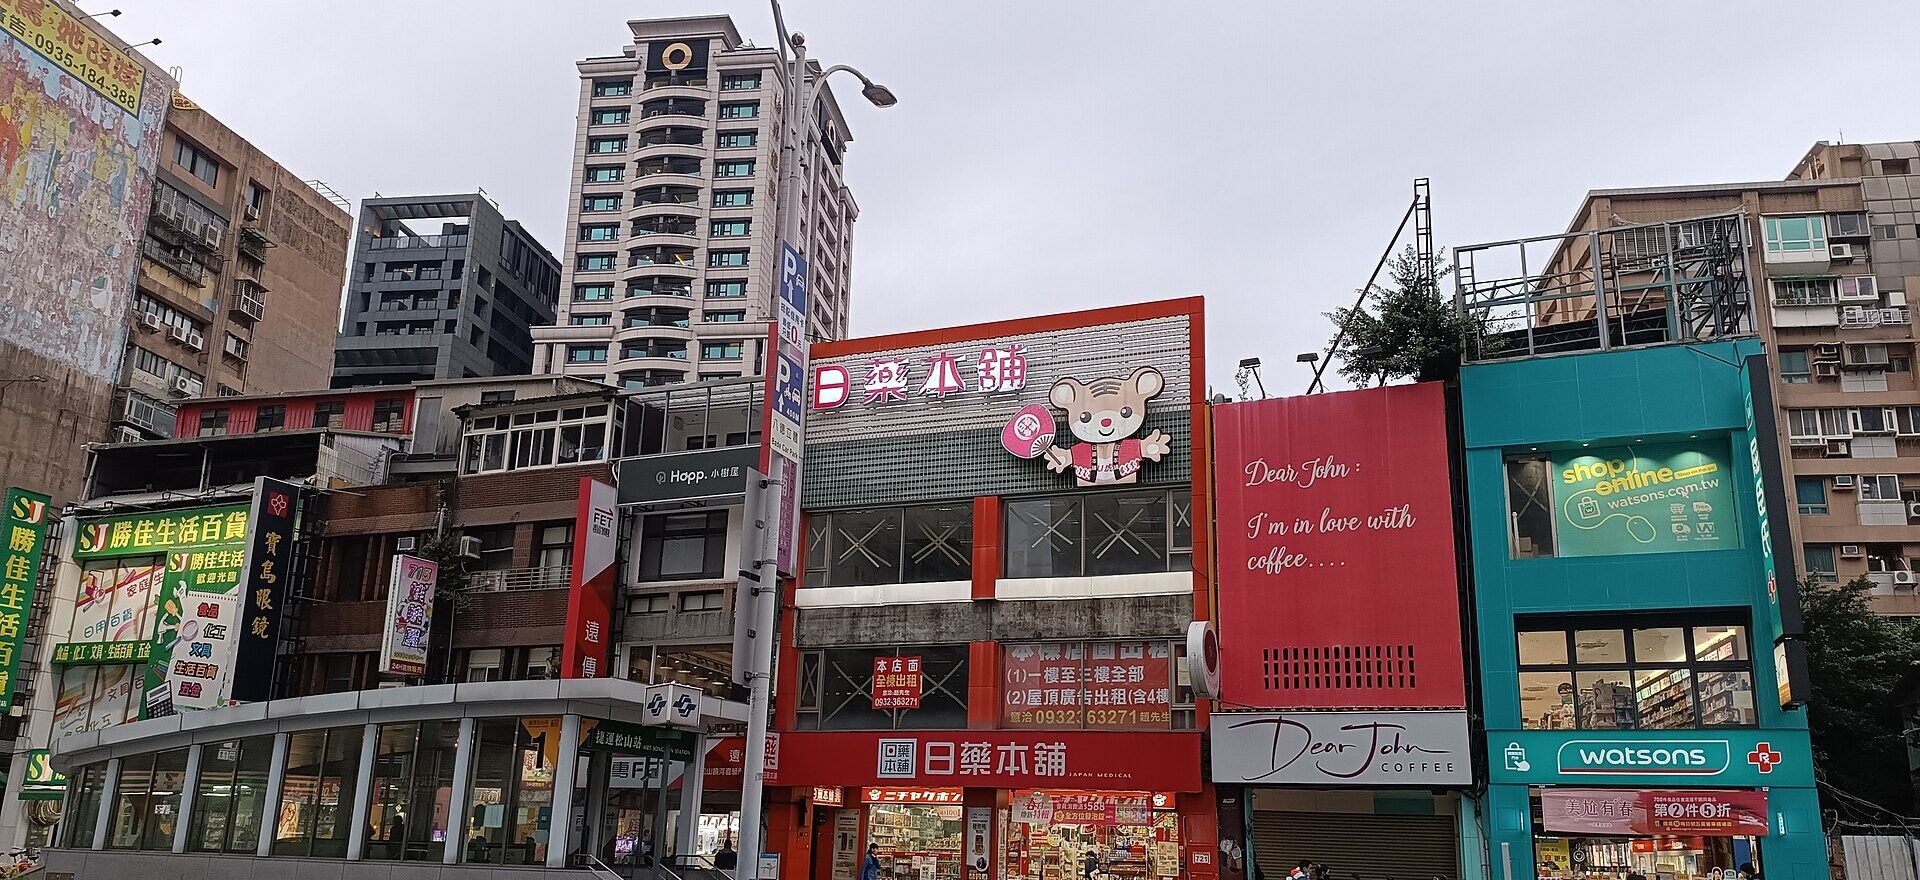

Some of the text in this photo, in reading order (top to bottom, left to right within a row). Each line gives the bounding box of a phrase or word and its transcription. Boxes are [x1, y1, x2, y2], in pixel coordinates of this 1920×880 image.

[784, 248, 797, 283] P
[776, 355, 791, 392] P
[813, 344, 1028, 410] 日藥本舖
[1245, 457, 1298, 487] Dear
[1298, 455, 1350, 489] John
[1562, 459, 1625, 485] shop
[1595, 467, 1674, 496] online
[1607, 478, 1720, 509] watsons.com.tw
[110, 511, 247, 549] 勝佳生活百貨
[593, 512, 614, 529] FET
[1293, 517, 1314, 534] in
[1319, 507, 1362, 533] love
[1367, 503, 1416, 530] with
[251, 531, 282, 639] 寶島眼鏡
[197, 602, 220, 619] 食品
[203, 623, 228, 640] 化工
[189, 642, 213, 658] 文具
[173, 660, 219, 680] 生活百貨
[877, 659, 918, 672] 本店面
[876, 674, 917, 687] 全棟出租
[875, 698, 918, 706] 0932-363271
[596, 729, 642, 749] 捷運松山站
[1228, 716, 1451, 781] Dear John
[925, 742, 1067, 776] 日藥本舖
[1579, 746, 1706, 765] watsons
[1381, 763, 1454, 773] COFFEE
[1654, 802, 1731, 818] 第2件5折
